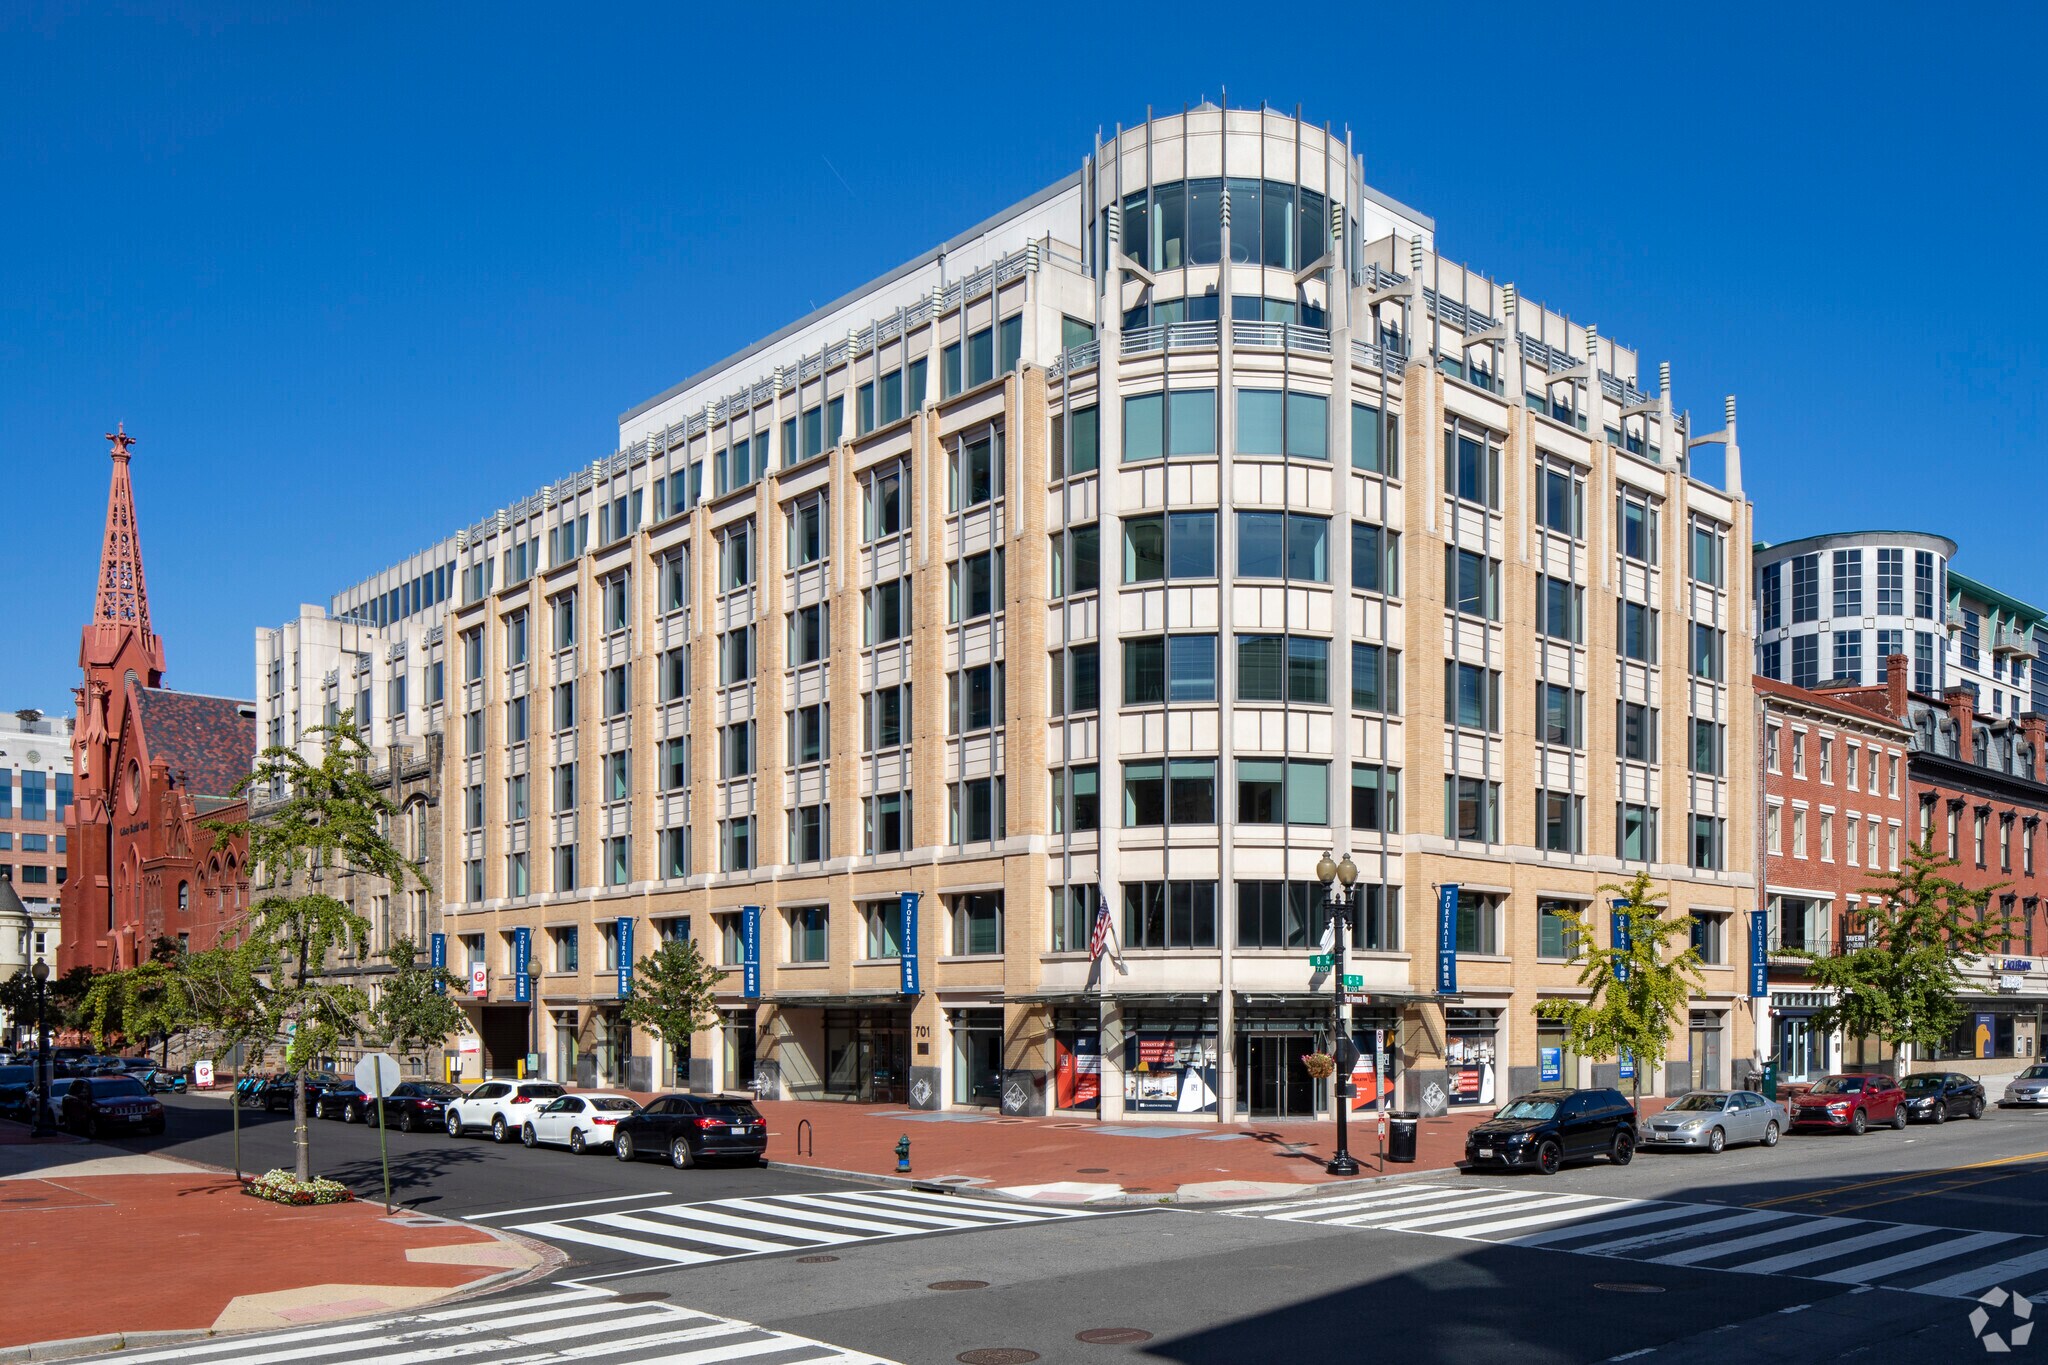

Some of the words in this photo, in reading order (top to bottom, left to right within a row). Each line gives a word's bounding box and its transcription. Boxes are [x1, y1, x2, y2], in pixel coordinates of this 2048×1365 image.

[1317, 956, 1321, 965] 8
[759, 1025, 771, 1035] 701
[915, 1025, 931, 1038] 701
